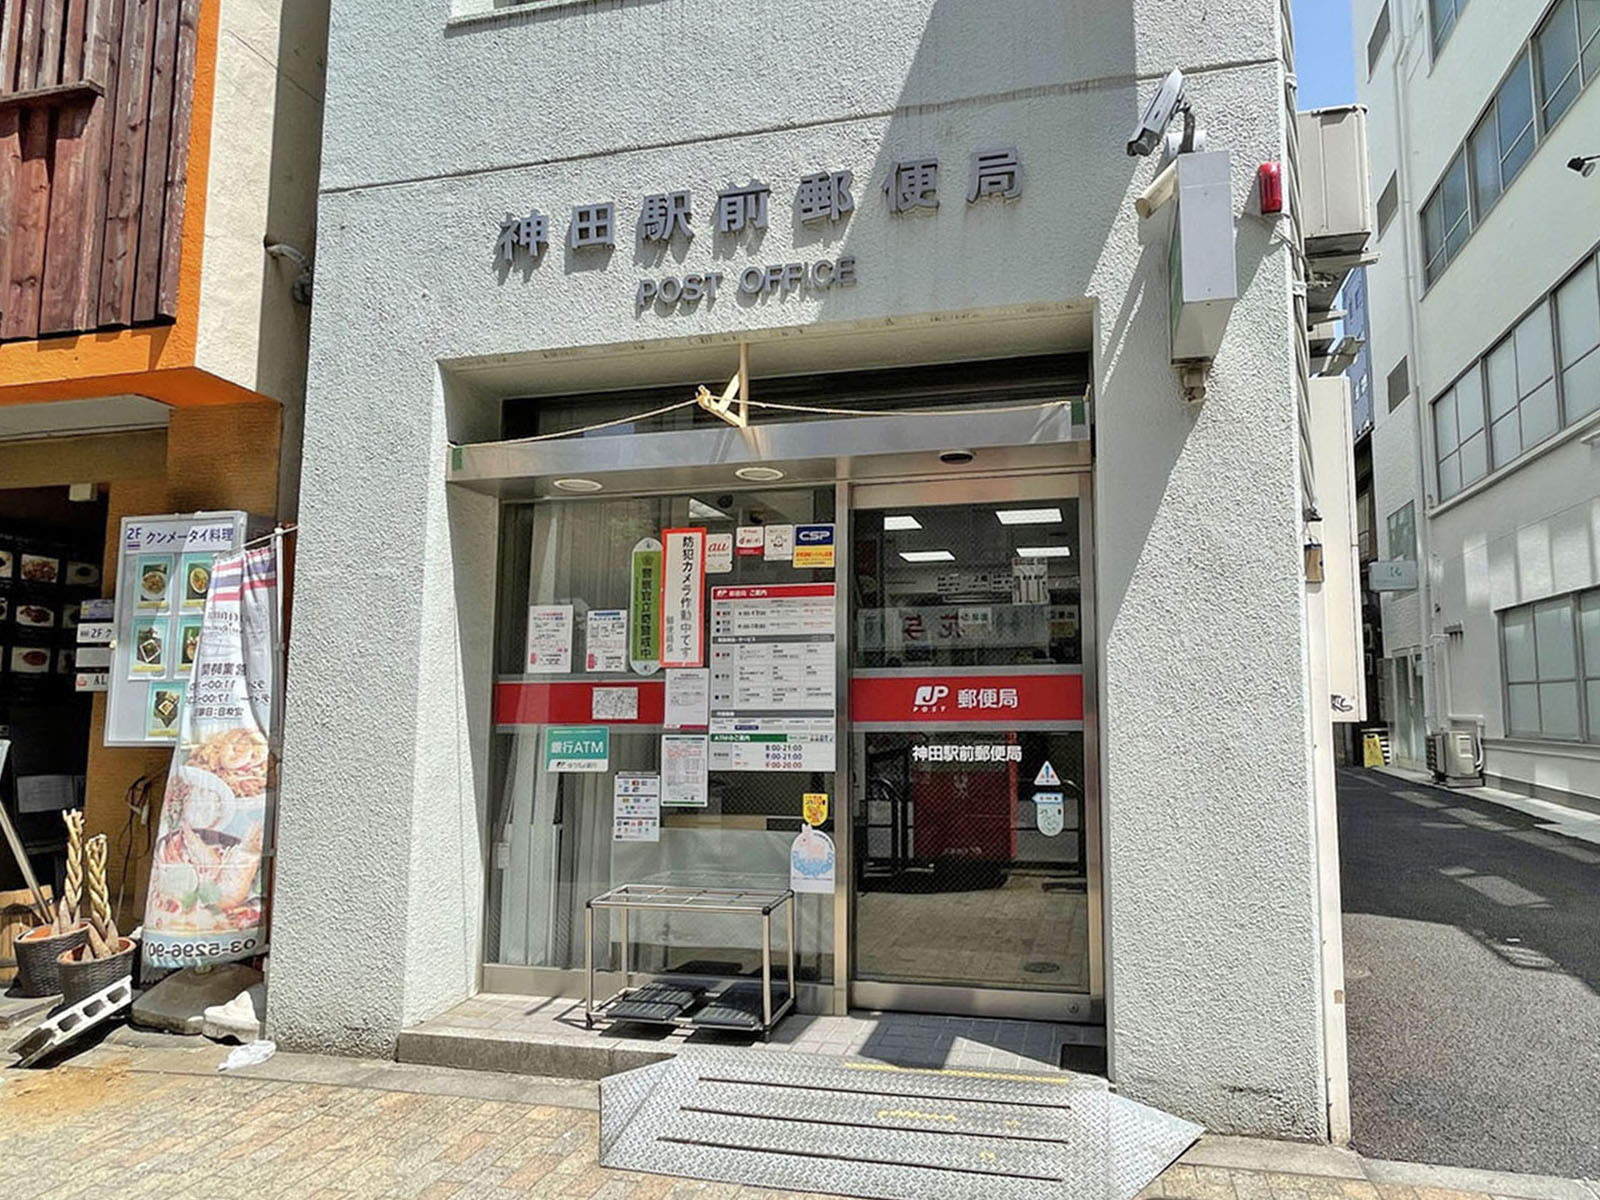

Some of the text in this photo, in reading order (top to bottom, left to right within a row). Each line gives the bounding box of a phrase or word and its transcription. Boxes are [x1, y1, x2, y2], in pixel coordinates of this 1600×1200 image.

[500, 146, 1023, 262] 神田駅前郵便局
[639, 256, 857, 307] POST OFFICE
[127, 527, 233, 544] 2F クンメータイ料理
[799, 531, 831, 542] CSP
[708, 543, 729, 552] au
[957, 688, 1019, 709] 郵便局
[551, 741, 604, 754] 銀行ATM
[912, 745, 1022, 762] 神田駅前郵便局
